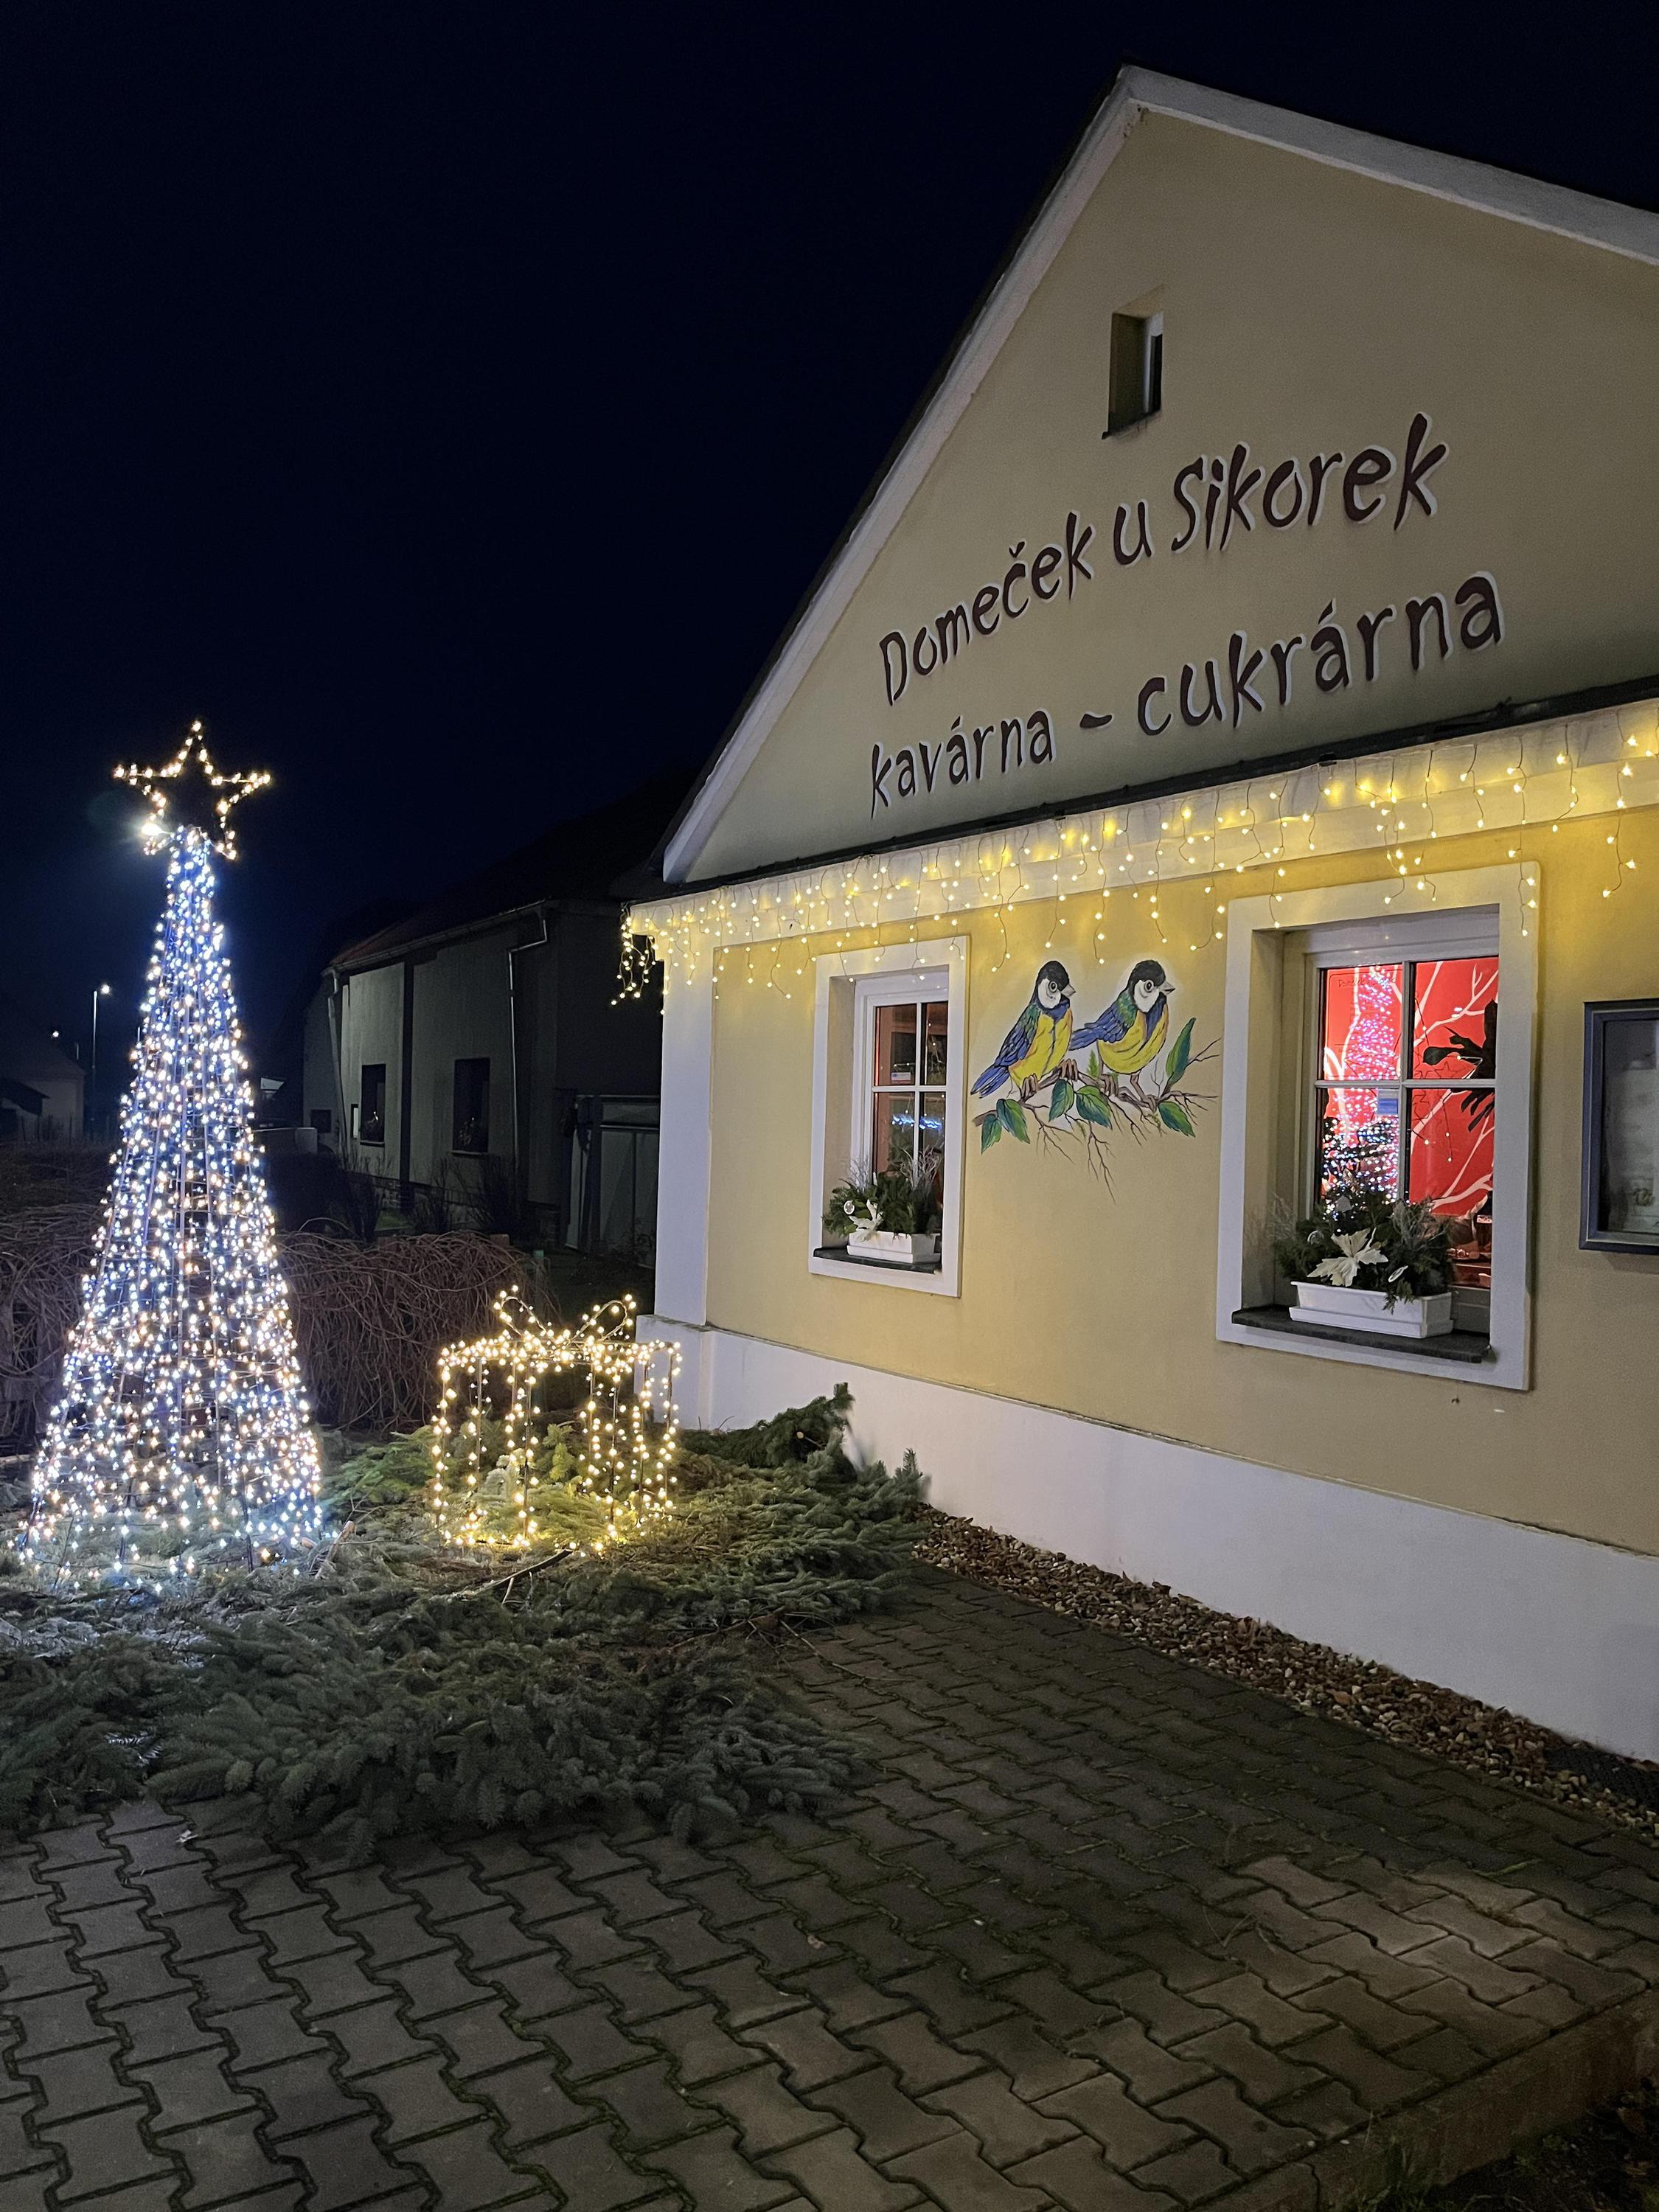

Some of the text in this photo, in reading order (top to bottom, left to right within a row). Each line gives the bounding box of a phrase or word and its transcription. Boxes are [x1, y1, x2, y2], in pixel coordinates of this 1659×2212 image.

[879, 411, 1448, 706] Domeček u Sikorek
[870, 709, 1054, 818] kavárna
[1138, 571, 1503, 736] cukrárna
